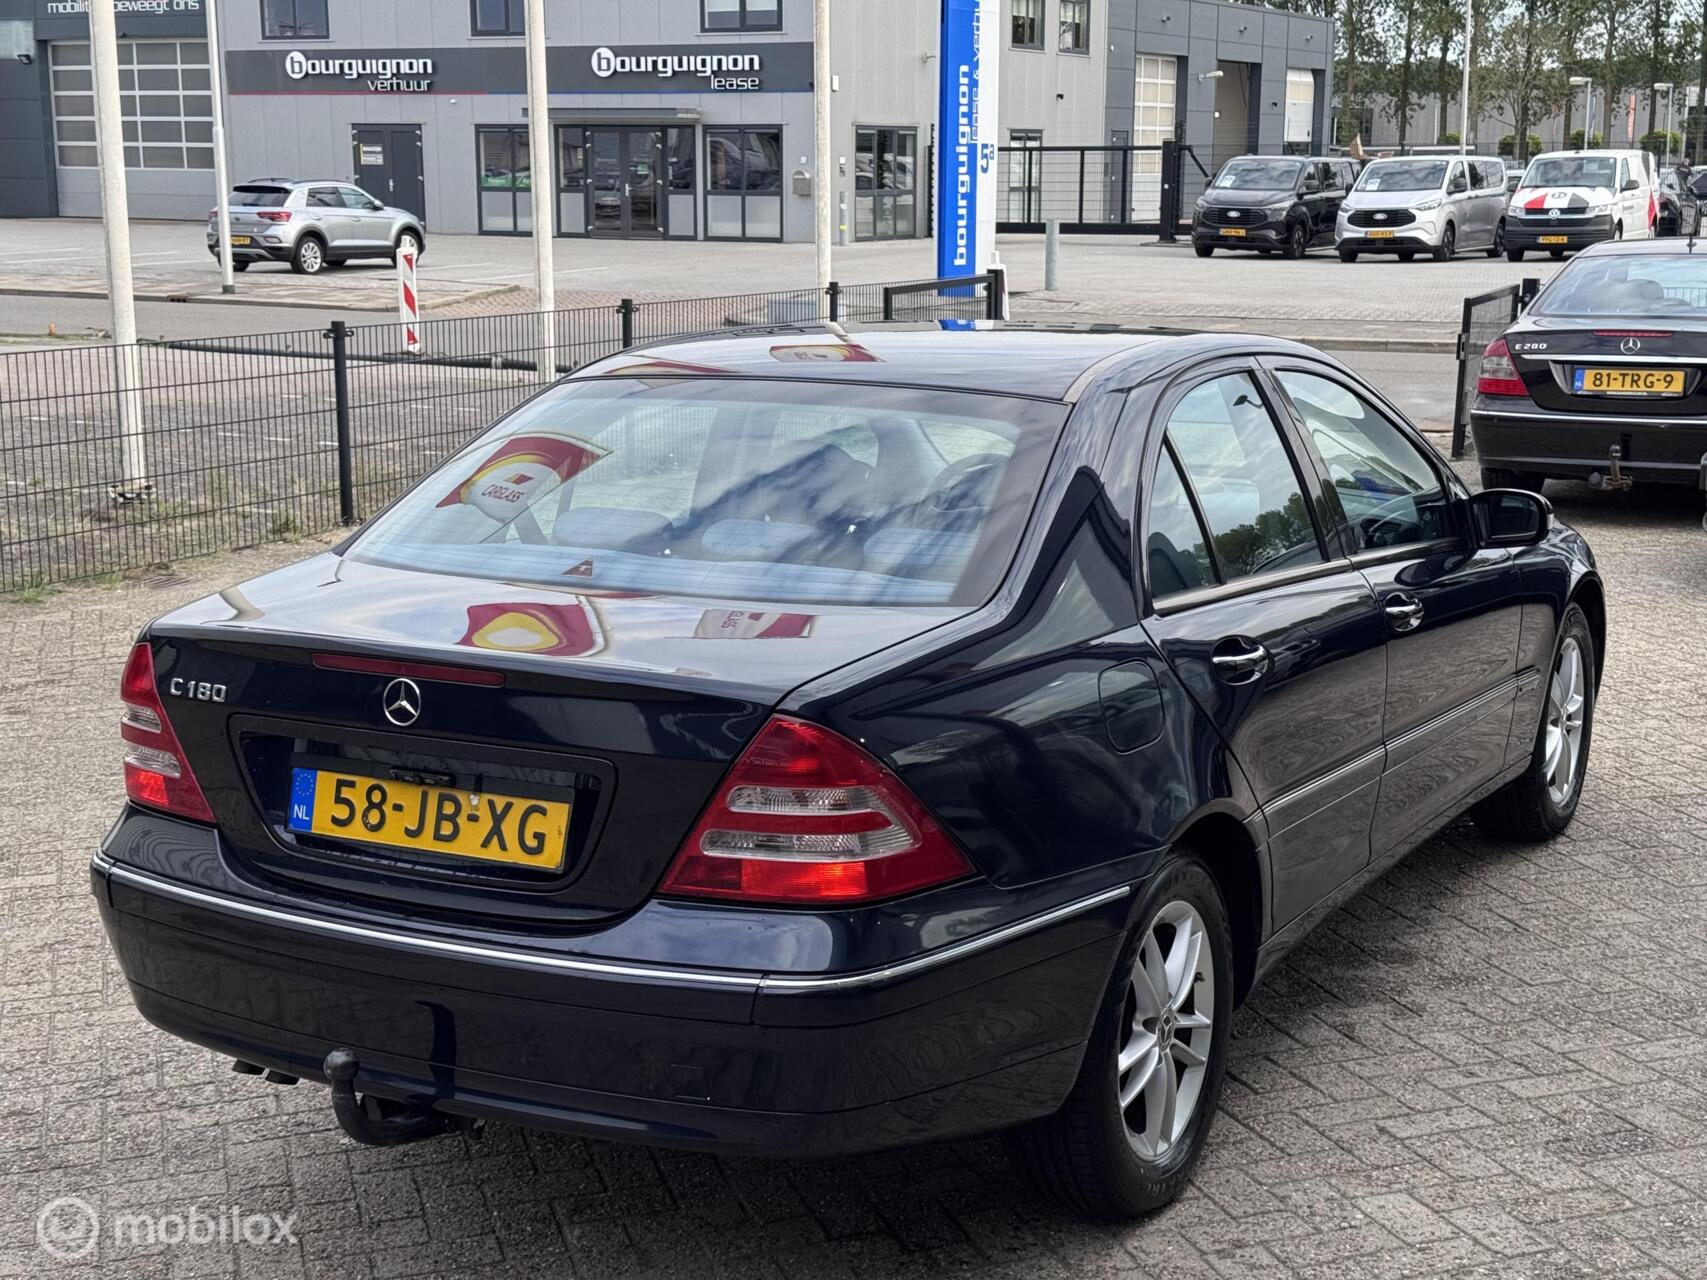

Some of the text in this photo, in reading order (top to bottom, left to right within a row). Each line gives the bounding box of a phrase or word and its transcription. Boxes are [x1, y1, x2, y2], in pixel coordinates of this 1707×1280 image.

[47, 0, 90, 14] mobilit
[173, 0, 200, 10] ons
[285, 51, 433, 79] bourguignon
[590, 47, 760, 77] bourguignon
[367, 77, 432, 91] verhuur
[711, 74, 759, 90] lease
[953, 65, 971, 267] bourguignon
[1592, 372, 1675, 389] 81-TRG-9
[170, 678, 227, 703] C 180
[293, 804, 310, 821] NL
[330, 778, 548, 856] 58-JB-XG
